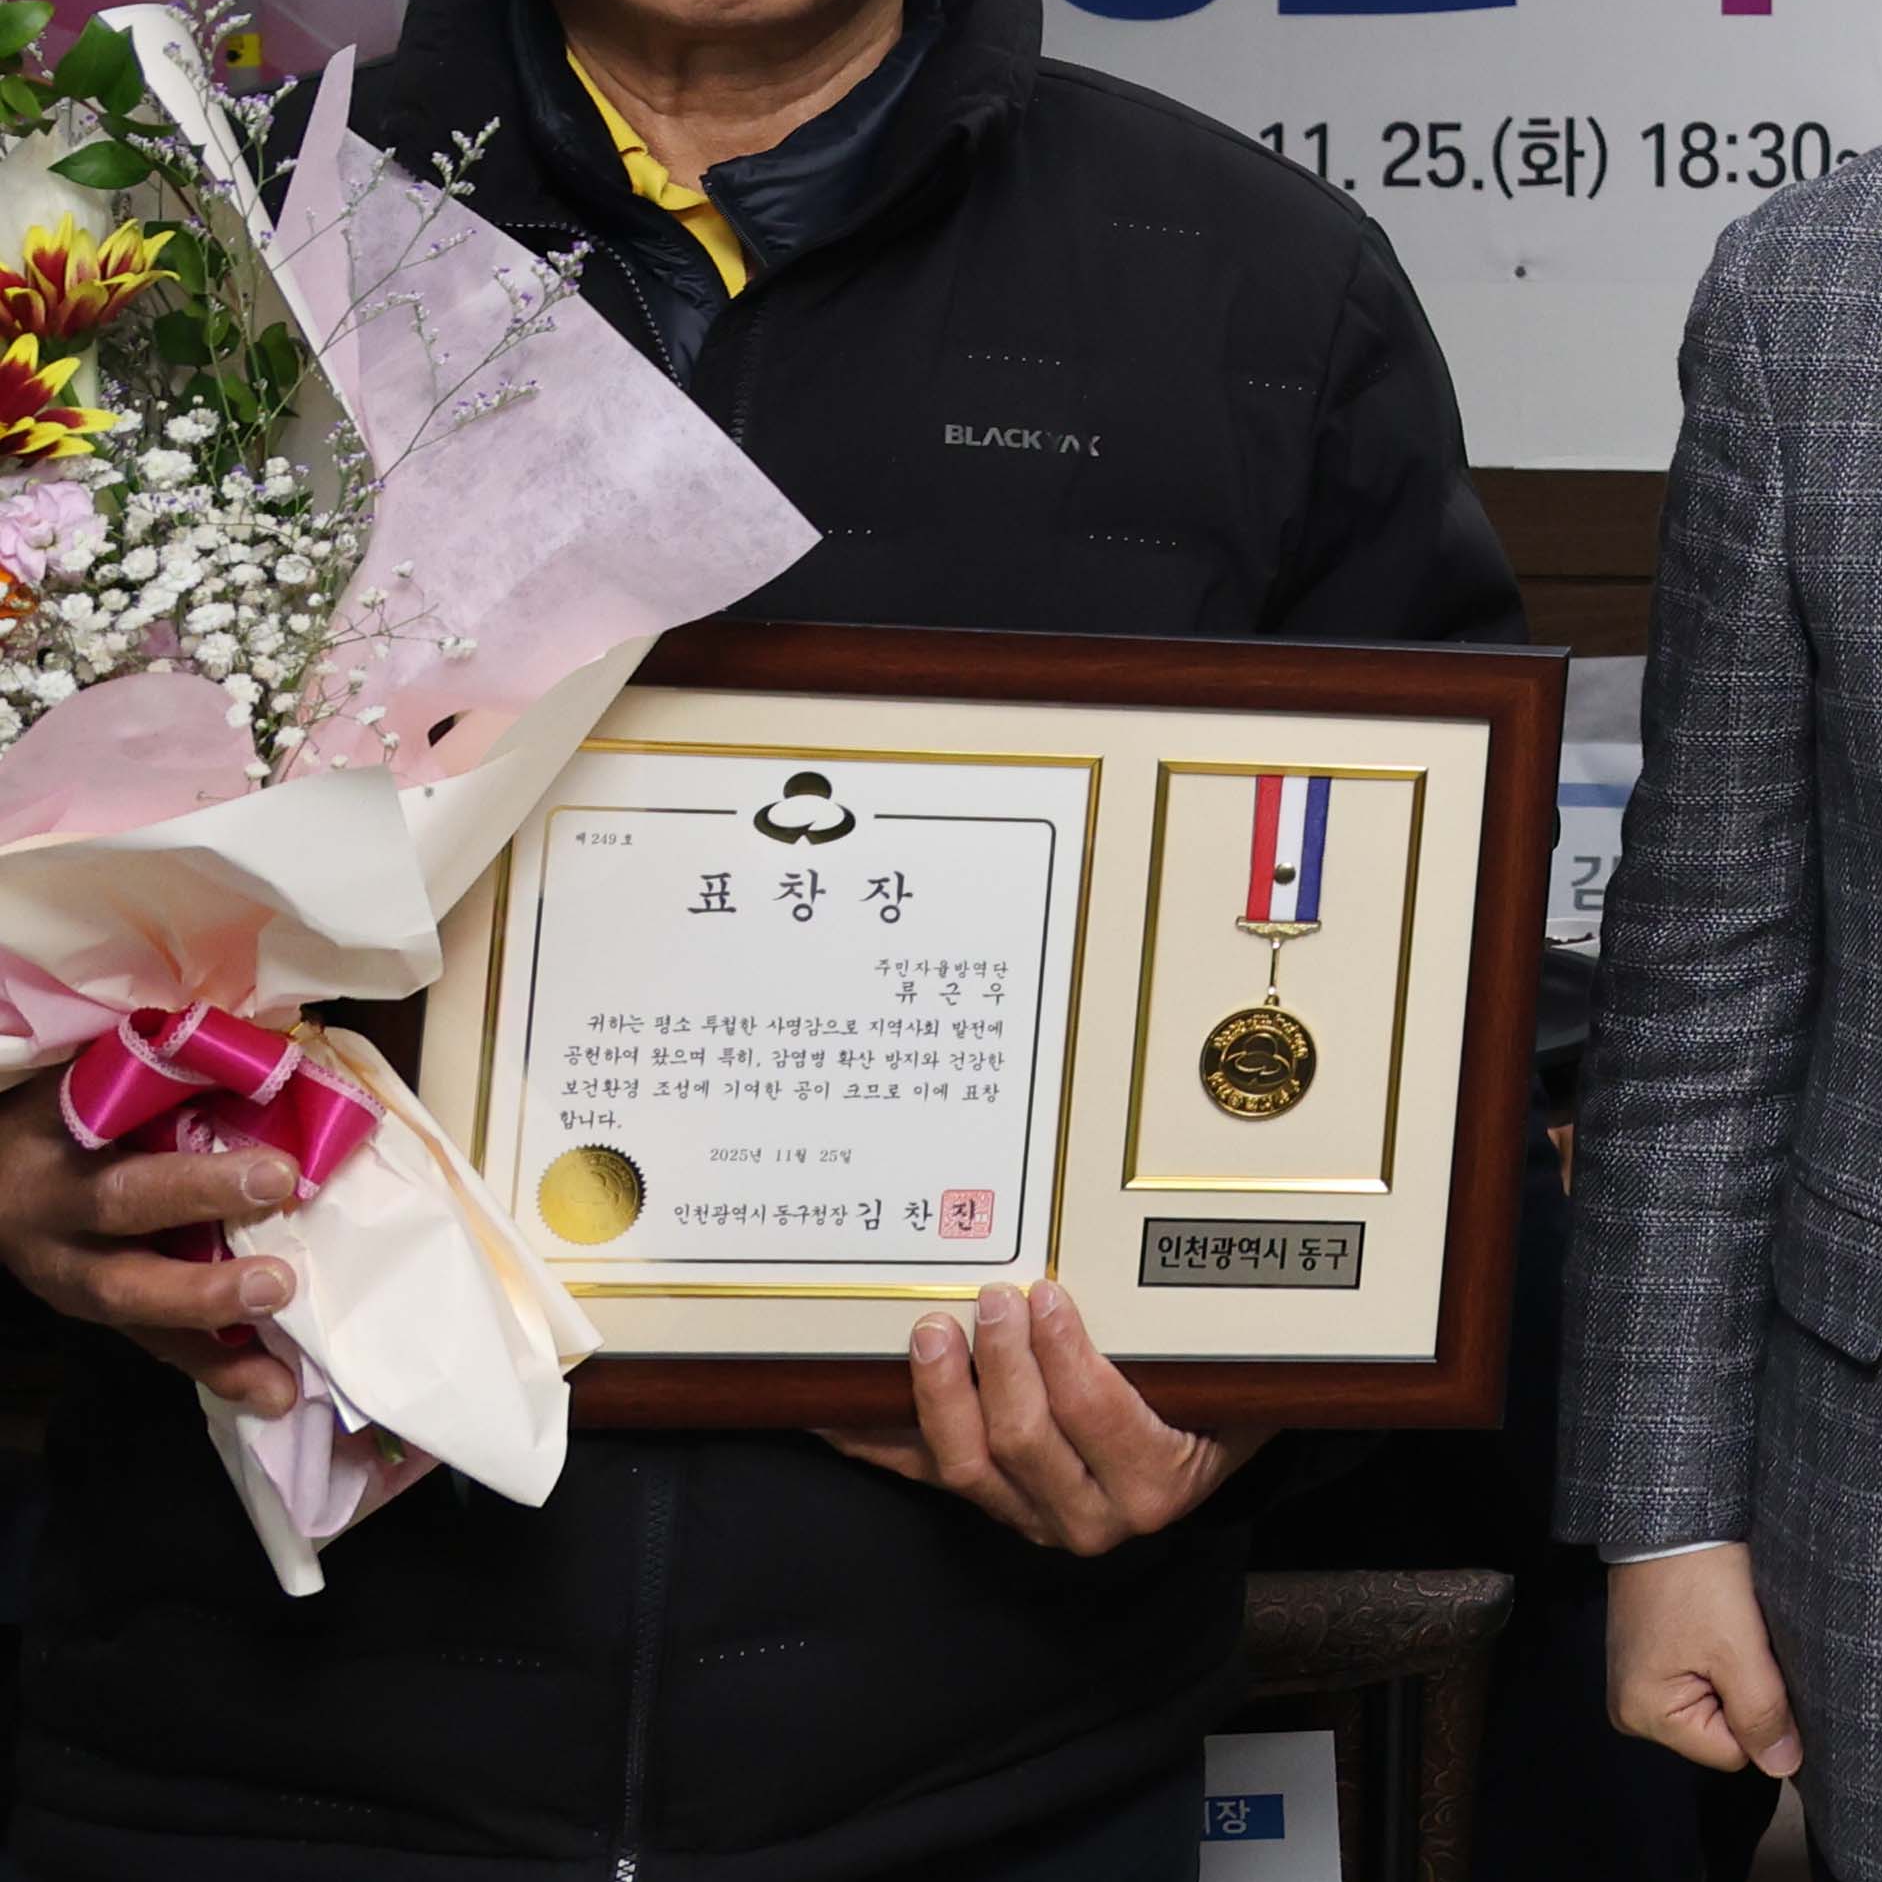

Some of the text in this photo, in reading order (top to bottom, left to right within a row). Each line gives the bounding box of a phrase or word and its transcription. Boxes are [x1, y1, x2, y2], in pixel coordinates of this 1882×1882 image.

[591, 832, 617, 846] 249
[874, 958, 1009, 980] 주민자율방역단
[586, 1013, 1004, 1041] 귀하는 평소 투철한 사명감으로 지역사회 발전에
[563, 1045, 639, 1067] 공헌하여
[650, 1046, 706, 1067] 왔으며
[772, 1048, 826, 1069] 감염병
[837, 1049, 876, 1071] 확산
[884, 1049, 941, 1071] 방지와
[949, 1050, 1006, 1072] 건강한
[561, 1077, 1001, 1104] 보건환경 조성에 기여한 공이 크므로 이에 표창
[559, 1109, 622, 1131] 합니다.
[709, 1147, 852, 1165] 2025년 11월 25일
[673, 1203, 767, 1226] 인천광역시
[772, 1203, 849, 1227] 동구청장
[1157, 1235, 1349, 1272] 인천광역시 동구
